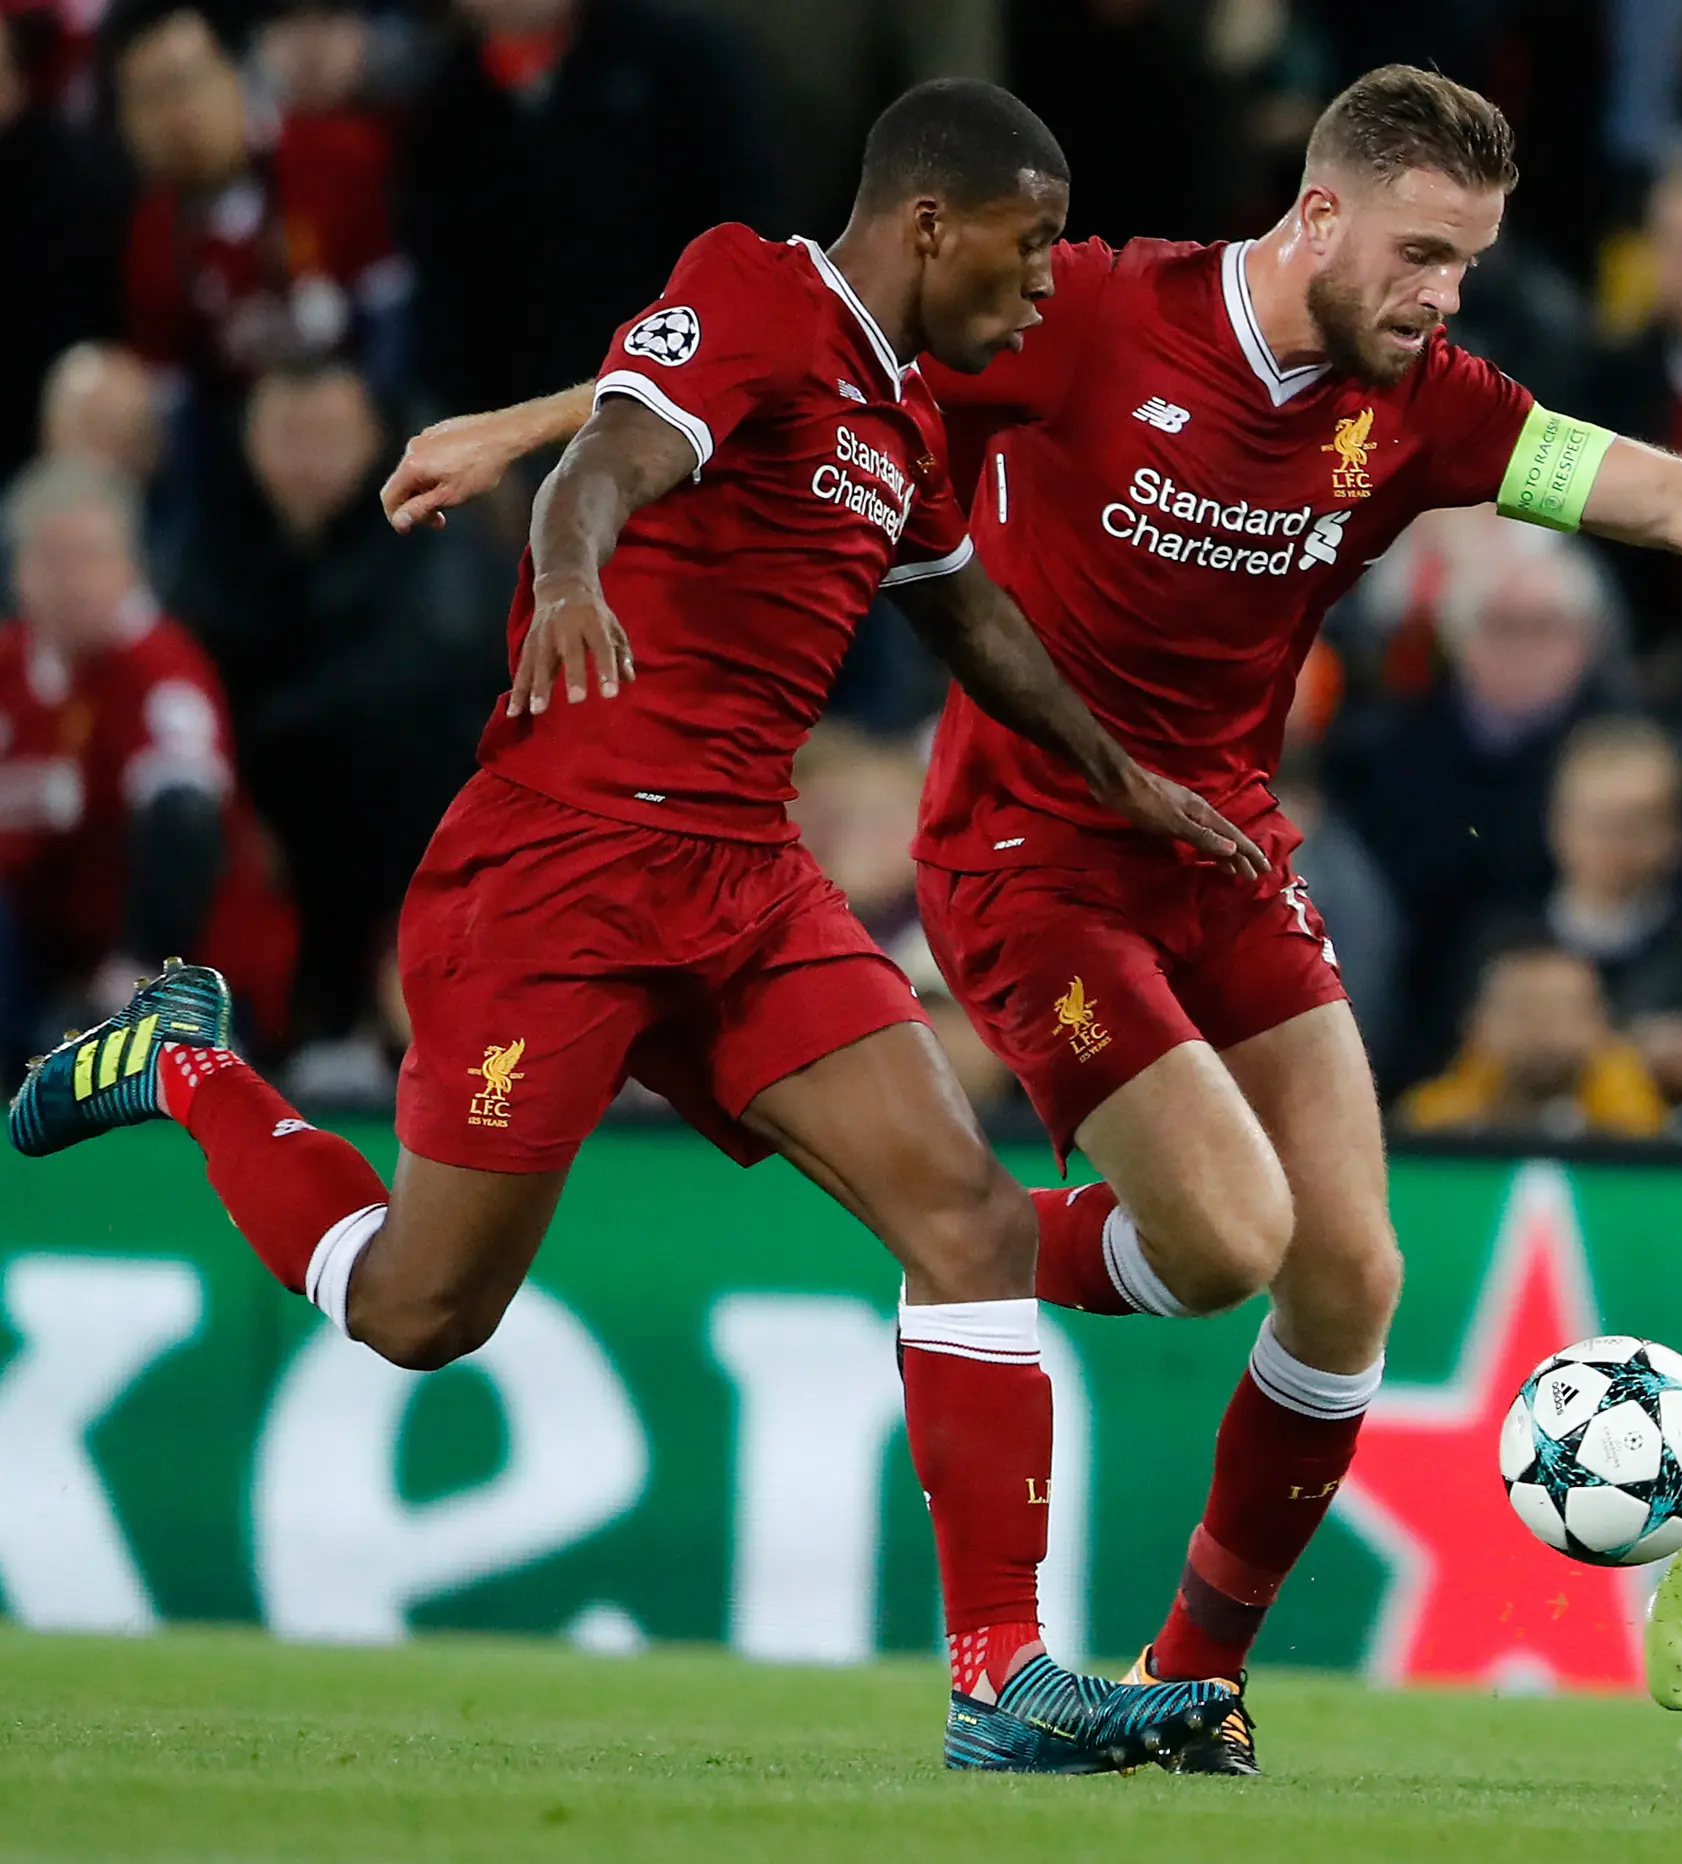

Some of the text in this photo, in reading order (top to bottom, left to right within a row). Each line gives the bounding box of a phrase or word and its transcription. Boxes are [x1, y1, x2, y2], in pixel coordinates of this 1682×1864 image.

[1525, 466, 1541, 488] TO
[1551, 427, 1586, 493] RESPECT
[1128, 467, 1312, 538] Standard
[1101, 502, 1296, 576] Chartered
[1552, 1380, 1565, 1416] adidas
